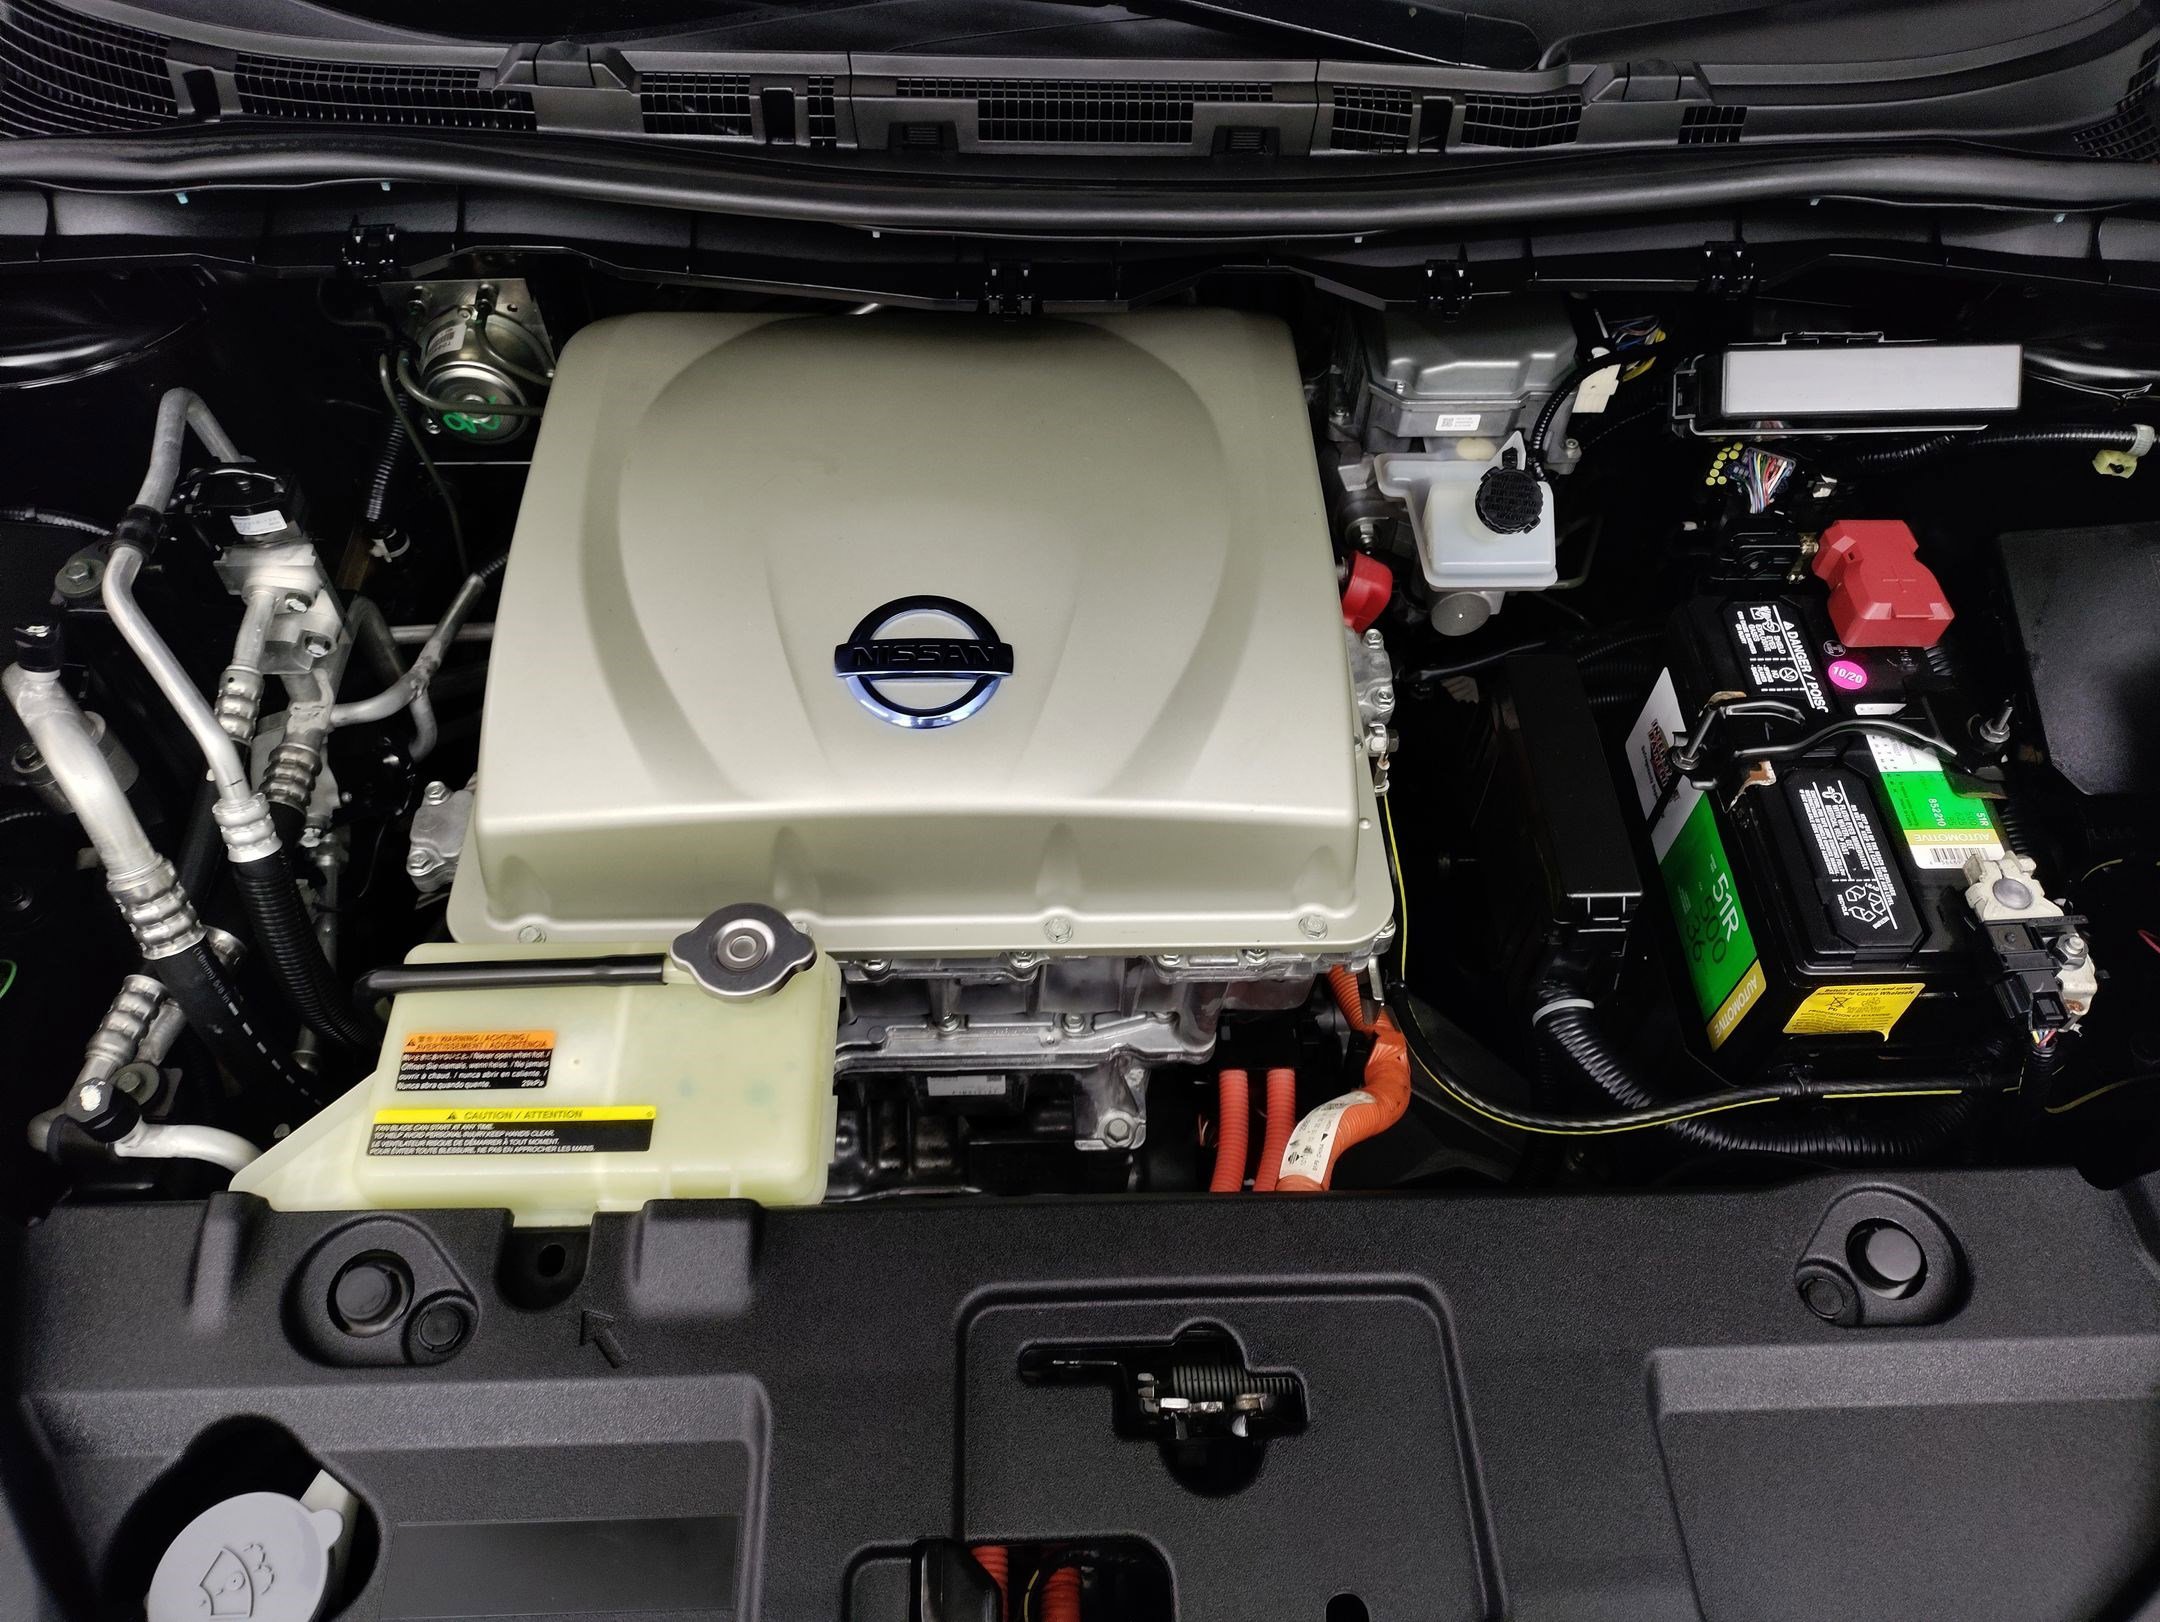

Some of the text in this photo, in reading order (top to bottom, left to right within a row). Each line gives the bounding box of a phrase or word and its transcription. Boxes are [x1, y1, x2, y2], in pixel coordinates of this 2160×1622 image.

[1748, 624, 1759, 641] GASES
[1756, 624, 1771, 651] EXPLOSIVE
[1774, 635, 1785, 654] SHIELD
[1788, 631, 1812, 672] DANGER
[853, 644, 995, 665] NISSAN
[1771, 670, 1779, 678] NO
[1832, 665, 1863, 684] 10/20
[1928, 798, 1947, 827] 852210
[1976, 812, 1990, 827] 51R
[1825, 804, 1850, 855] MEDICAL HELP FAST
[1832, 804, 1842, 818] WITH
[1846, 839, 1855, 850] GET
[1839, 804, 1870, 870] FLUSH EYES IMMEDIATELY
[1914, 833, 1991, 842] AUTOMOTIVE
[1712, 872, 1740, 943] 51R
[1837, 894, 1849, 915] RECYCLE
[1700, 894, 1727, 965] 500
[1714, 974, 1758, 1038] AUTOMOTIVE
[440, 1034, 479, 1042] WARNING
[473, 1052, 495, 1060] Never
[524, 1060, 550, 1069] jamais
[399, 1073, 420, 1081] ouvrir
[481, 1070, 500, 1078] abrir
[396, 1081, 421, 1090] Nunca
[420, 1081, 438, 1090] abra
[437, 1081, 465, 1090] quando
[464, 1111, 512, 1120] CAUTION
[523, 1110, 584, 1120] ATTENTION
[509, 1138, 529, 1146] TOUT
